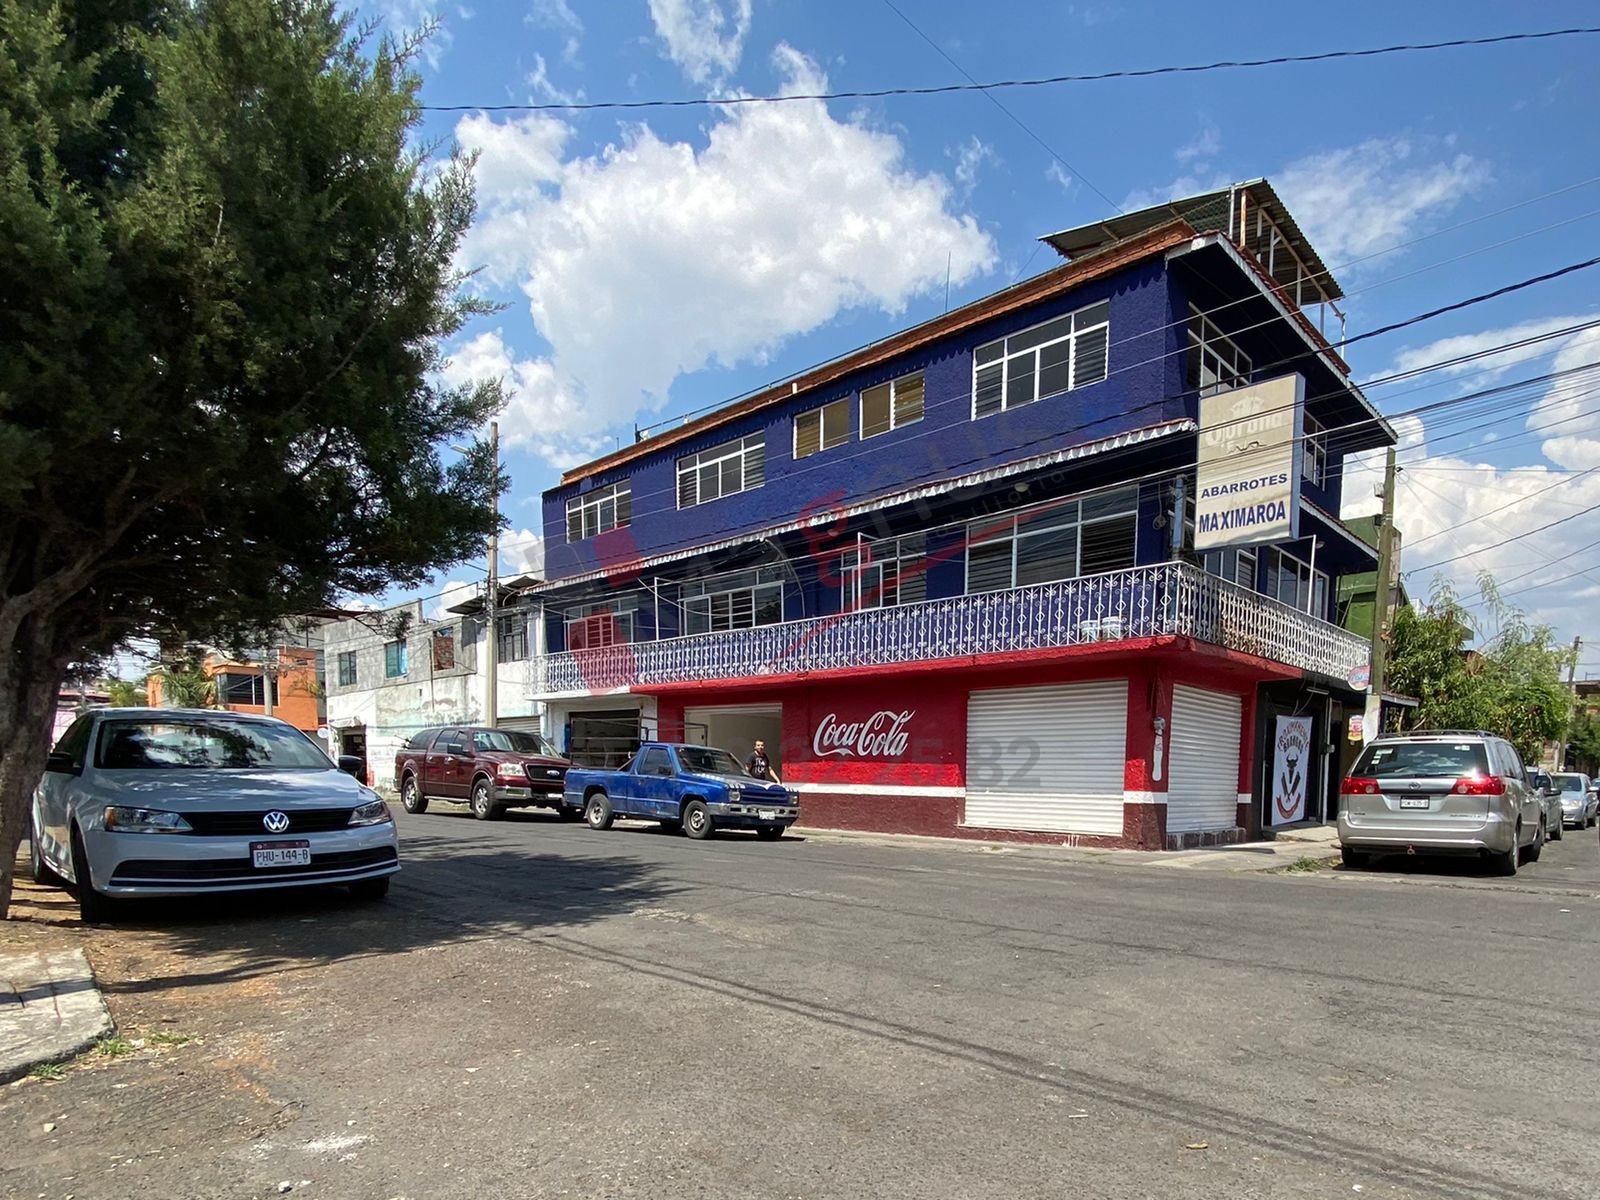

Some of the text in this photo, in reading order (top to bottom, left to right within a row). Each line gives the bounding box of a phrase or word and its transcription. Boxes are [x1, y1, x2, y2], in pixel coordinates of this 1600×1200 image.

[1201, 473, 1287, 498] ABARROTES
[1199, 501, 1286, 533] MAXIMAROA
[813, 710, 916, 757] Coca-Cola
[256, 849, 308, 862] PHU-144-B
